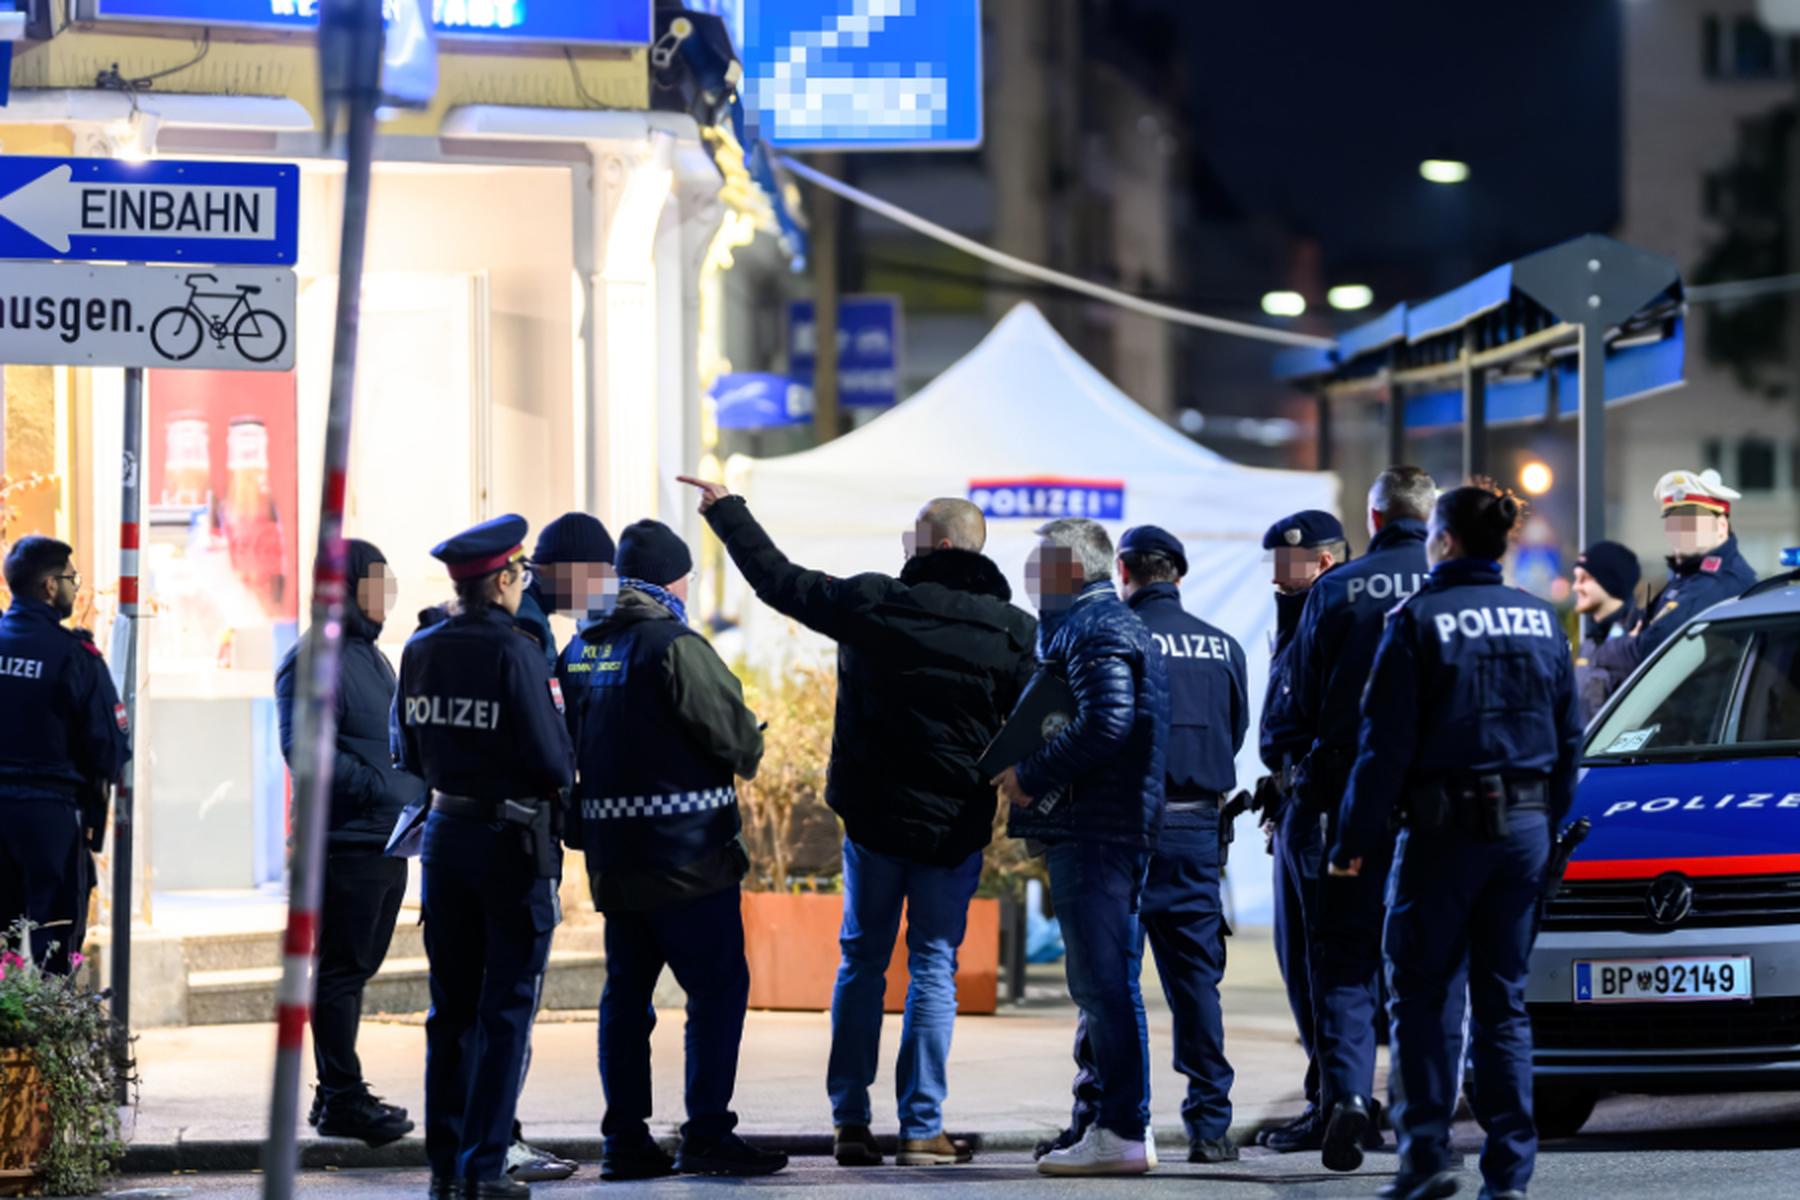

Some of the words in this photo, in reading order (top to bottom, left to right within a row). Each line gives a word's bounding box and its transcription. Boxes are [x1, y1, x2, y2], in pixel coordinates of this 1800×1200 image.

[81, 189, 260, 232] EINBAHN
[0, 296, 145, 343] usgen.
[1347, 573, 1430, 603] POLI
[1434, 607, 1553, 643] POLIZEI
[405, 696, 500, 730] POLIZEI
[1655, 964, 1735, 993] 92149
